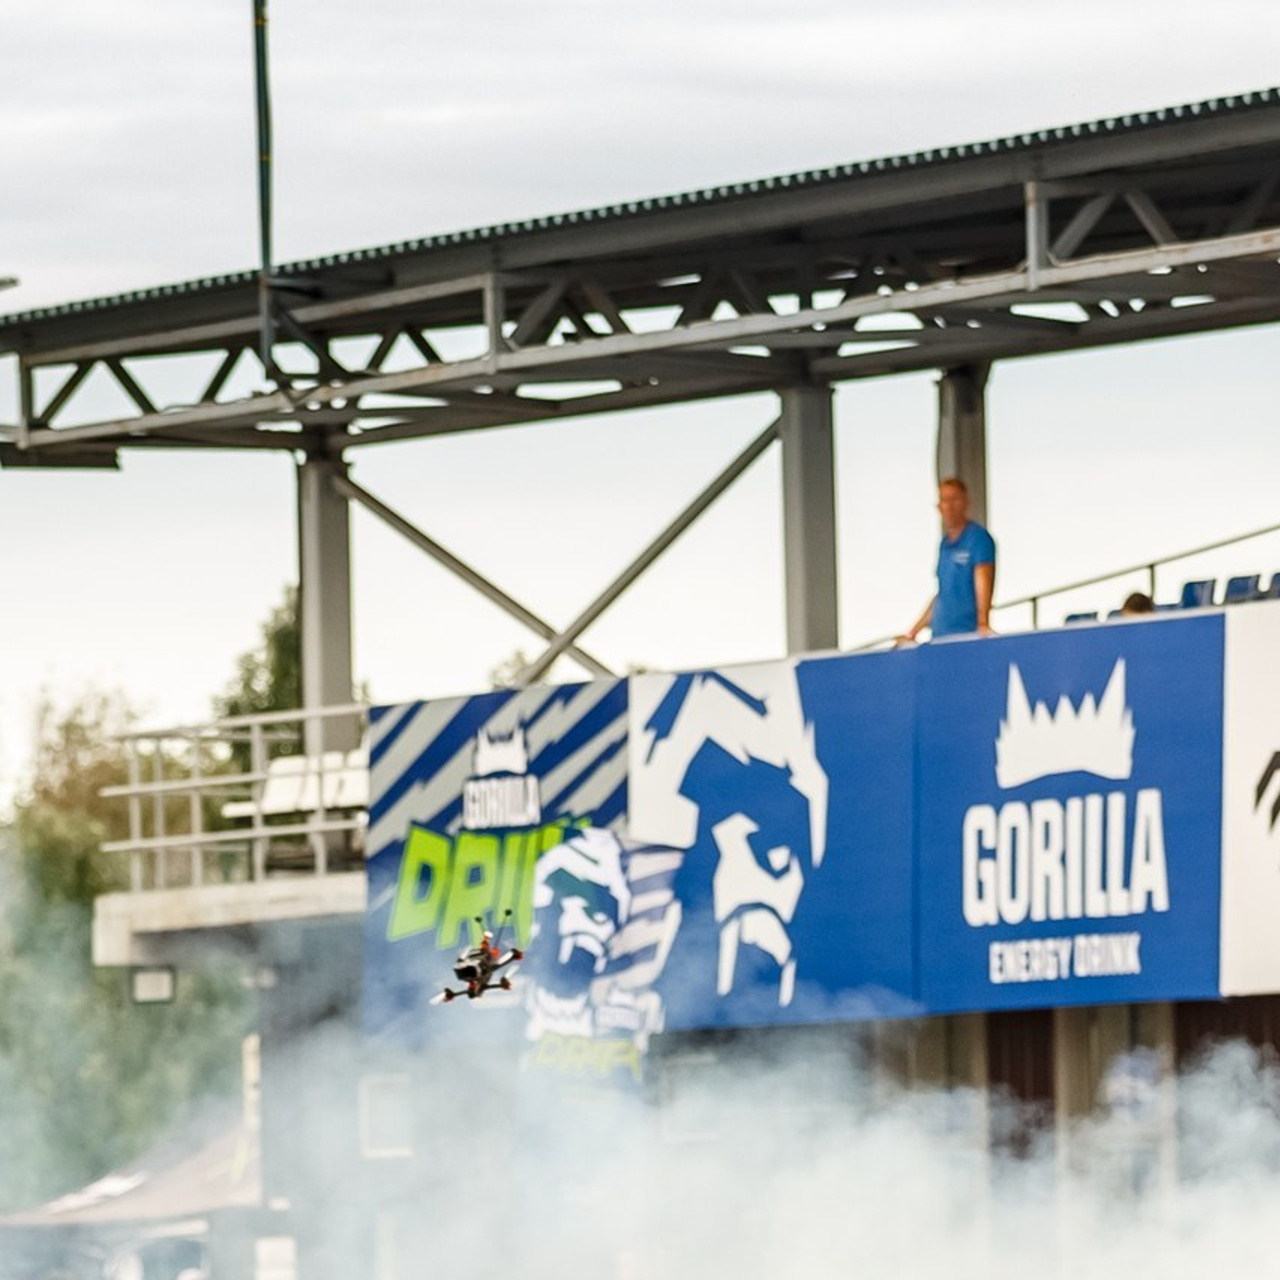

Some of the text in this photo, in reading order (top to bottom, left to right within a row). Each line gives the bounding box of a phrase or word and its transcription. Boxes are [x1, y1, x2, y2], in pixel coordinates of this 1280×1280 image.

[962, 787, 1170, 927] GORILLA
[989, 931, 1141, 984] ENERGY DRINK
